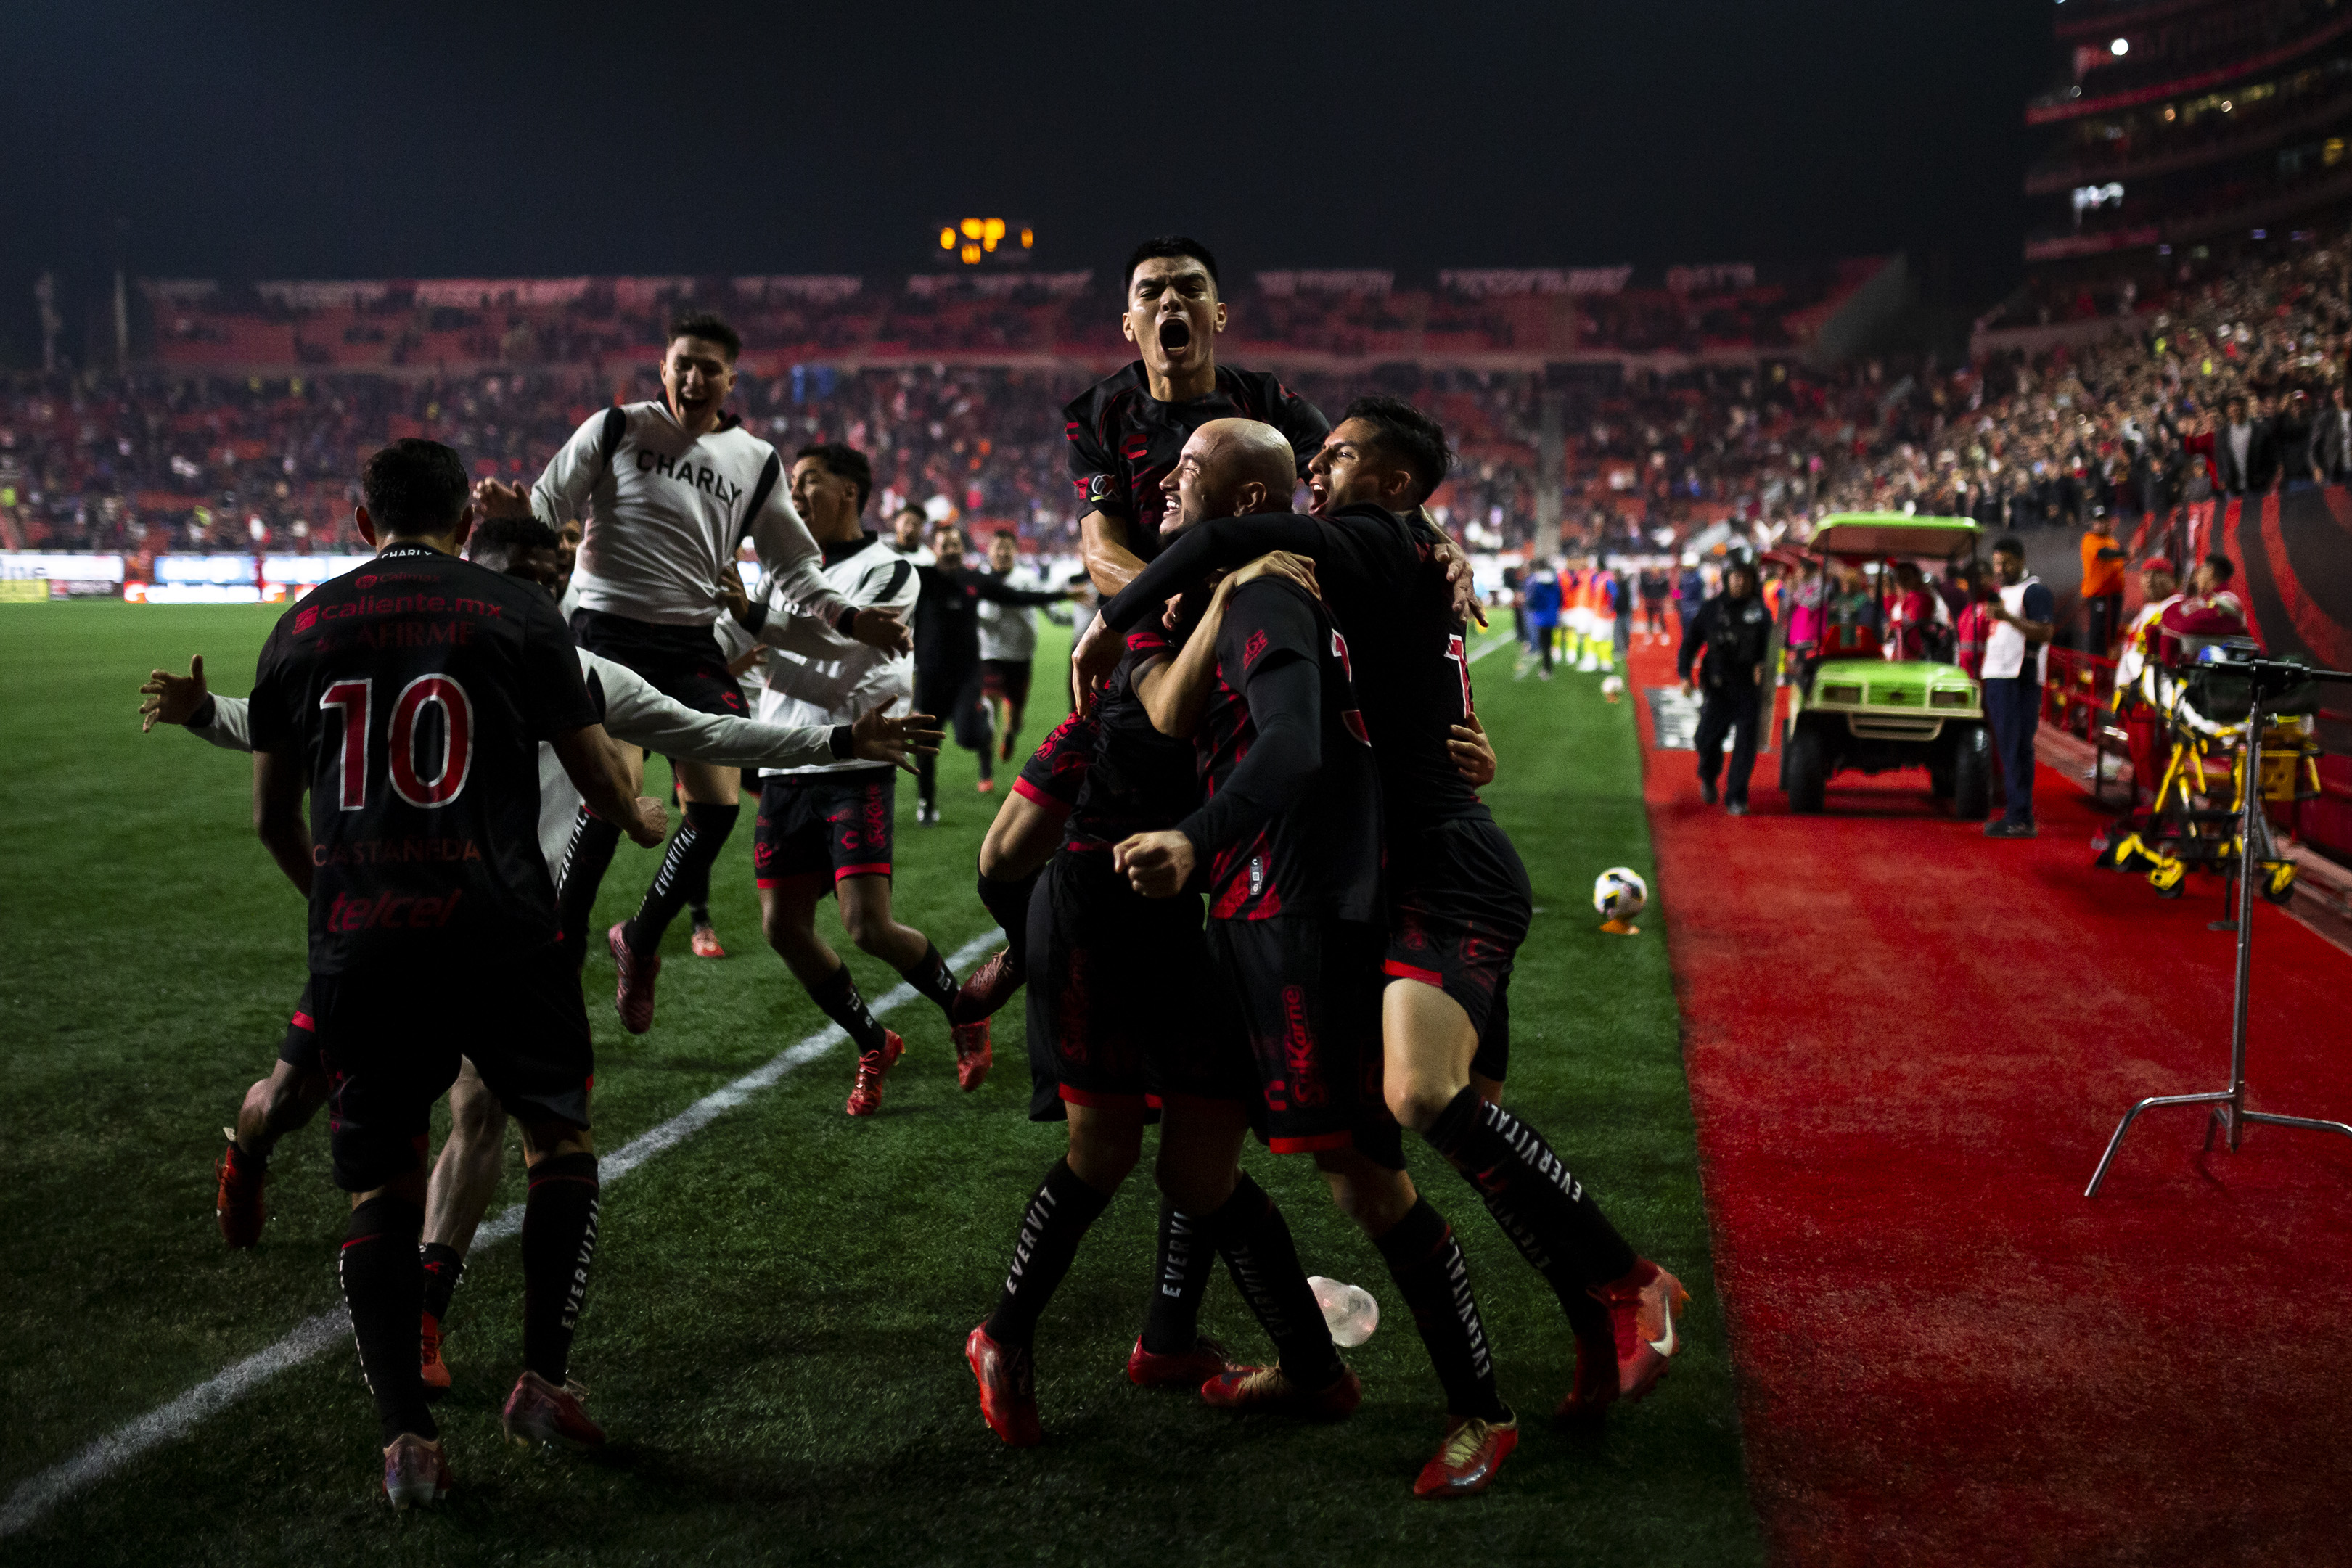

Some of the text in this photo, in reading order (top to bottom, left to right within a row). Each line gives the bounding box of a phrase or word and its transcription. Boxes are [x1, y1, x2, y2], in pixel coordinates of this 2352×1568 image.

[636, 449, 742, 509] CHARLY
[321, 593, 503, 620] caliente.mx
[356, 620, 475, 652] AFIRME
[319, 673, 475, 812] 10
[311, 834, 482, 867] CASTAÑEDA
[327, 887, 464, 933] telcel
